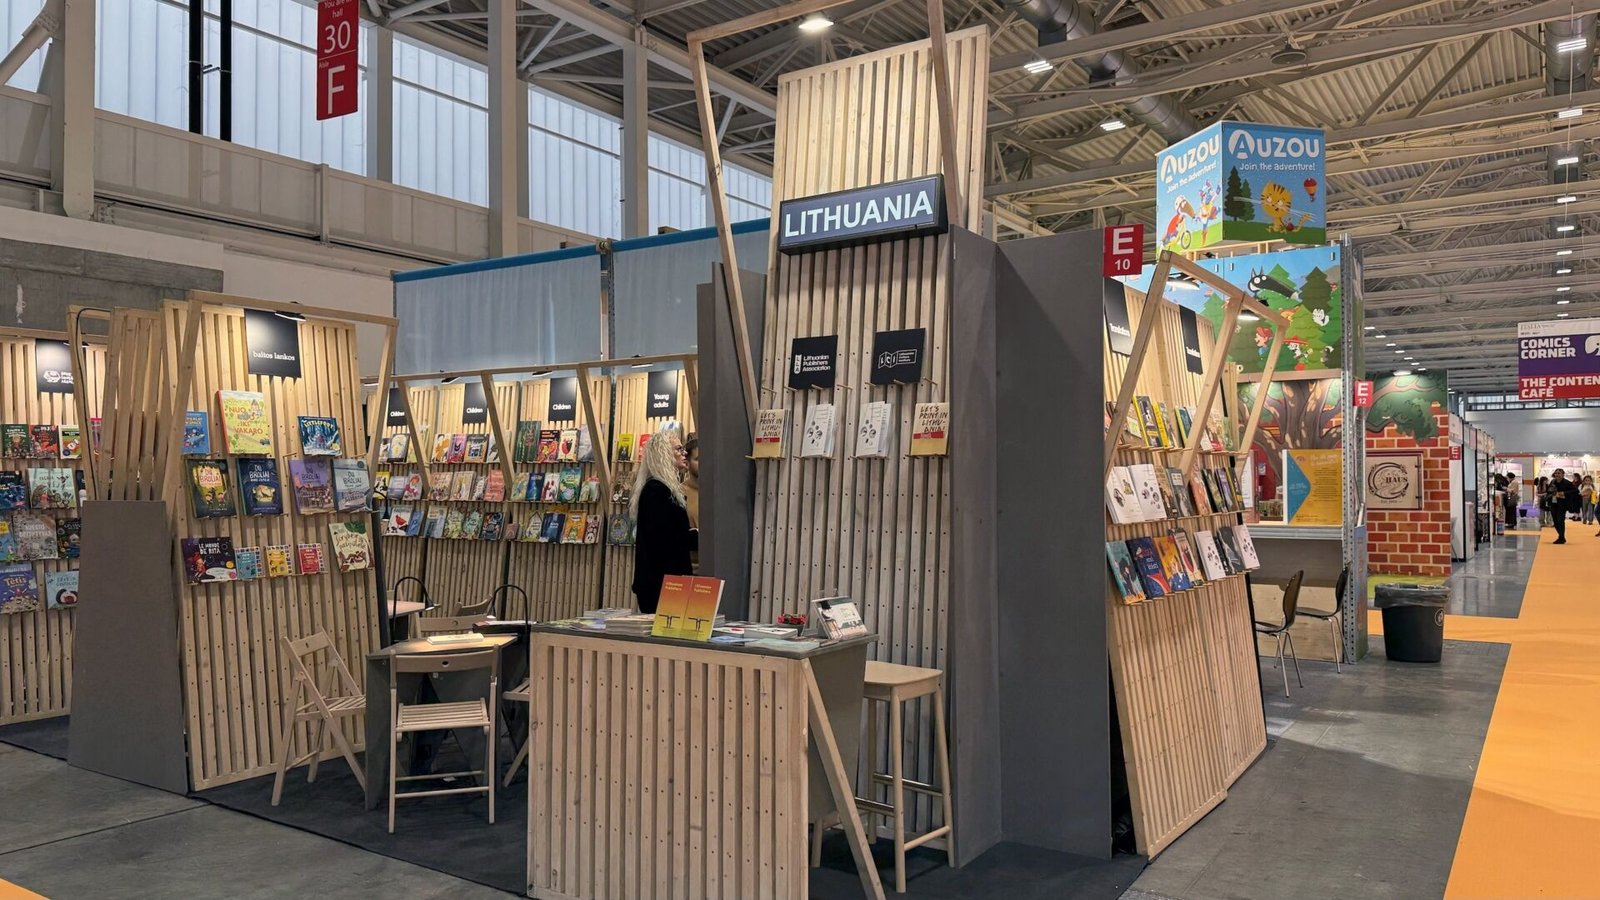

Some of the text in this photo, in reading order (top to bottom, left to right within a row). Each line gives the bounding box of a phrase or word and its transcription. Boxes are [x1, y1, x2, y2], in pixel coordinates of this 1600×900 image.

[332, 8, 344, 18] hall
[324, 20, 350, 54] 30
[328, 65, 346, 114] F
[1228, 129, 1320, 160] AUZOU
[1161, 134, 1220, 184] AUZOU
[1240, 162, 1316, 170] Join the adventure!
[1168, 160, 1216, 192] Join the adventure!
[785, 190, 933, 237] LITHUANIA
[1112, 227, 1134, 256] E
[1115, 258, 1130, 270] 10
[1520, 338, 1570, 349] COMICS
[252, 350, 295, 360] baltos lankos
[1520, 348, 1576, 360] CORNER
[1358, 382, 1368, 396] E
[1521, 378, 1546, 388] THE
[1522, 386, 1554, 398] CAFÉ
[1452, 446, 1459, 454] E
